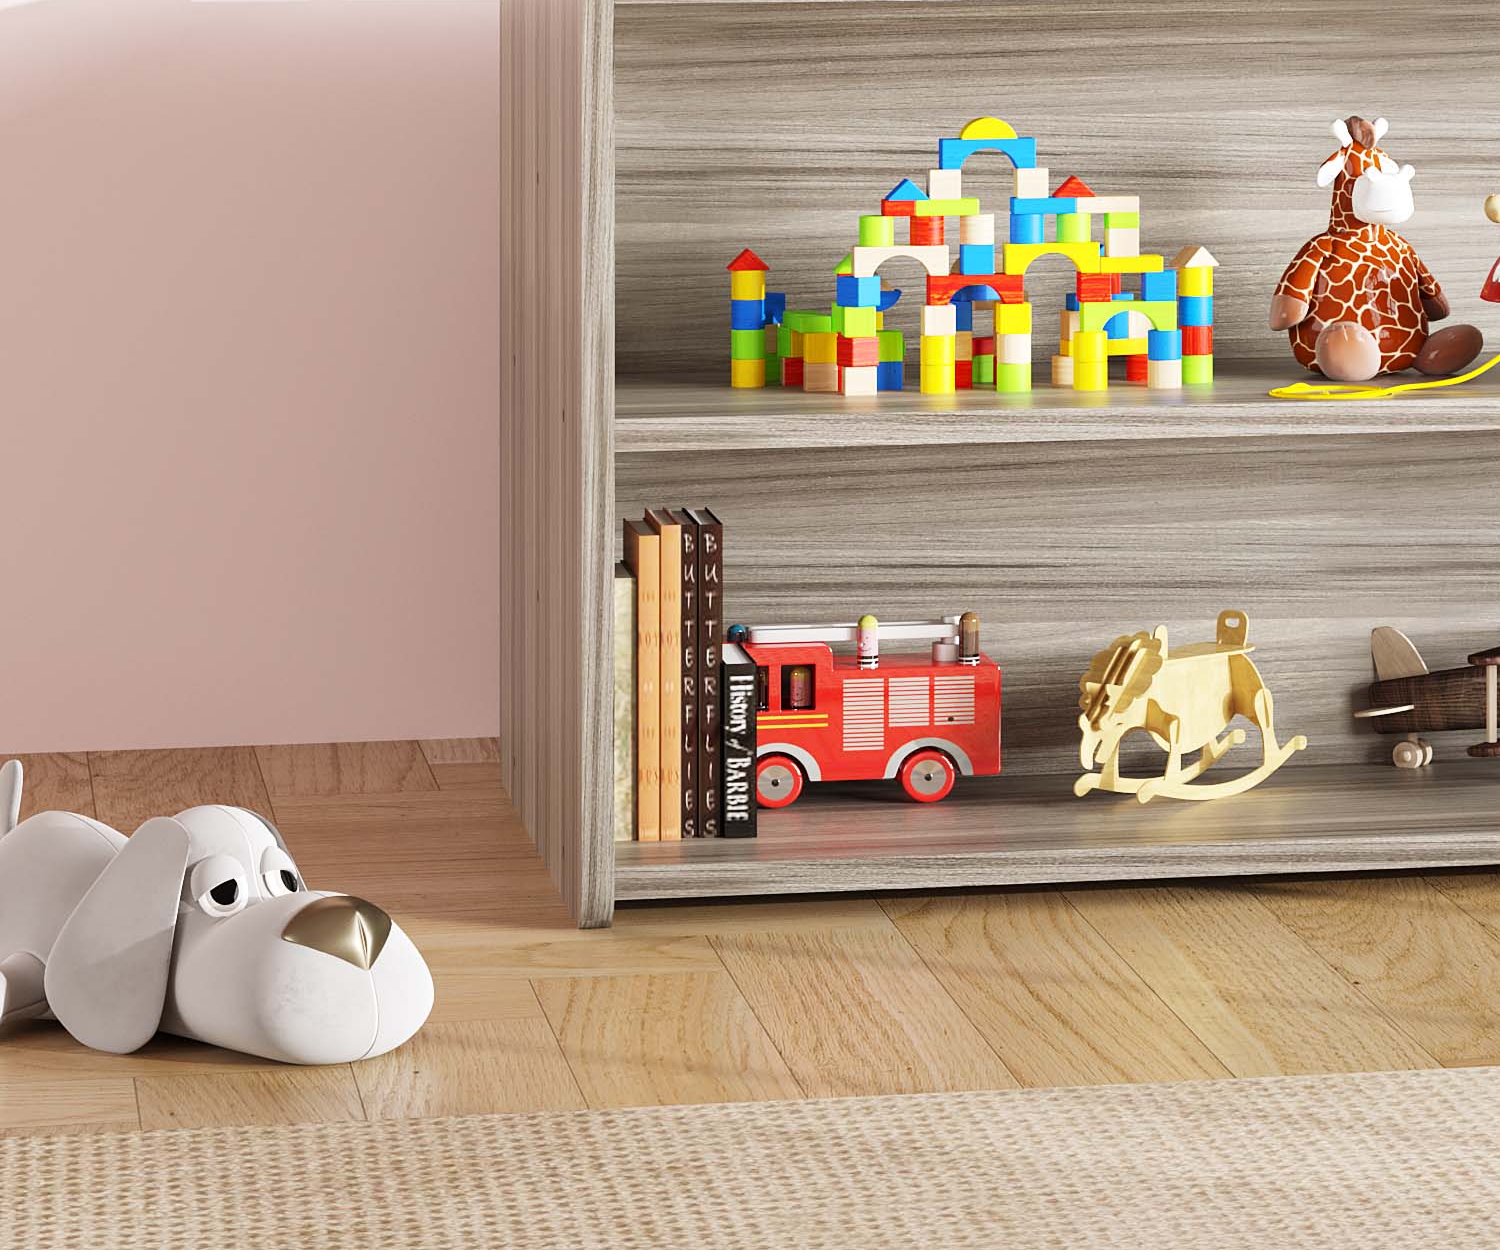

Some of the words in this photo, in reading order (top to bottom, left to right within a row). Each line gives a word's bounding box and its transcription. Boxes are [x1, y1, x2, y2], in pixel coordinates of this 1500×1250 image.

[683, 533, 695, 837] BUTTERFLIES
[703, 533, 718, 837] BUTTERFLIES
[725, 675, 754, 735] History
[726, 757, 752, 821] BARBIE
